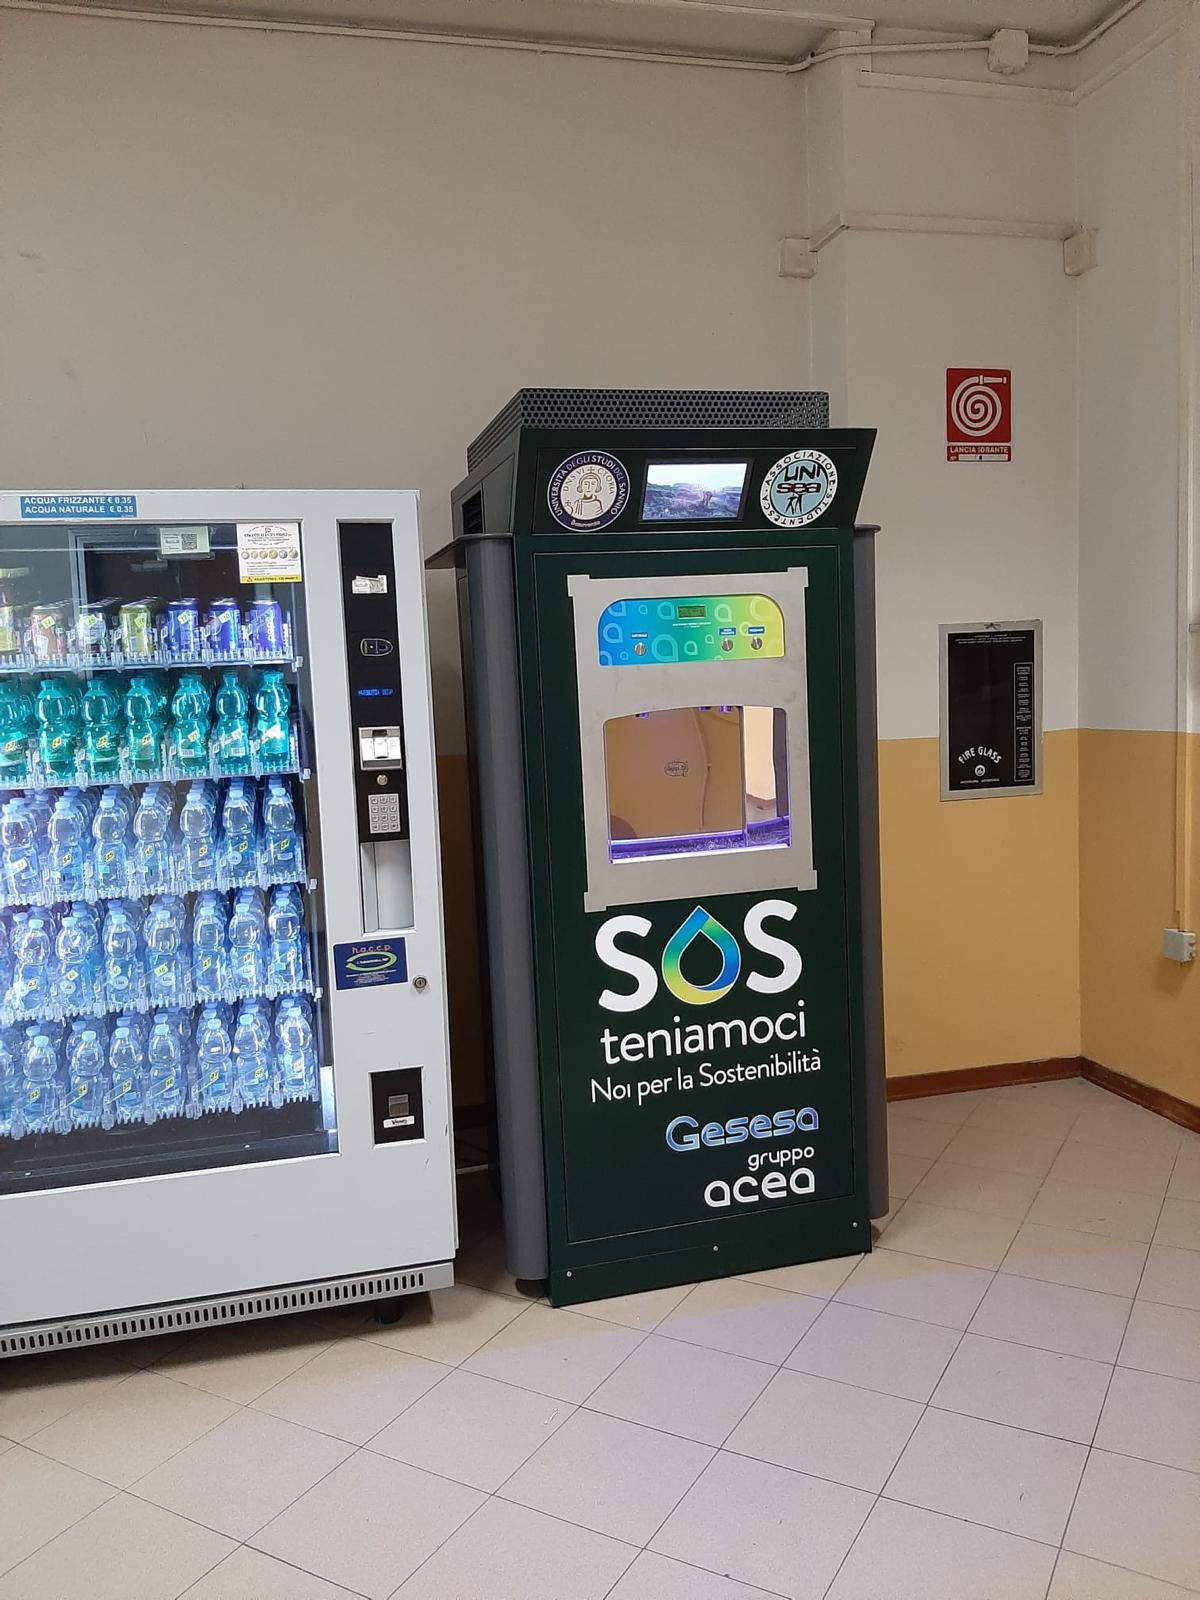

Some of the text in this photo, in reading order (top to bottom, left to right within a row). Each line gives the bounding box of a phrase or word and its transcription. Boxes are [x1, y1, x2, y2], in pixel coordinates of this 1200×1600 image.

[949, 446, 1009, 454] LANCIA IDRANTE
[566, 455, 591, 471] DEGLI
[591, 455, 616, 470] STUDI
[610, 482, 627, 515] SANNIO
[764, 451, 836, 487] ASSOCIAZIONE
[24, 496, 56, 504] ACQUA
[58, 496, 106, 504] FRIZZANTE
[114, 496, 132, 504] 0.35
[25, 505, 57, 513] ACQUA
[59, 505, 105, 513] NATURALE
[116, 505, 134, 513] 0.35
[762, 493, 833, 526] STUDENTESCA
[958, 746, 1003, 764] FIRE GLASS
[595, 899, 802, 1013] SOS
[600, 999, 806, 1065] teniamoci
[637, 1077, 672, 1106] per
[677, 1067, 693, 1090] la
[699, 1047, 821, 1087] Sostenibilità
[665, 1106, 819, 1152] Gesesa
[747, 1146, 815, 1172] gruppo
[703, 1167, 815, 1208] acea
